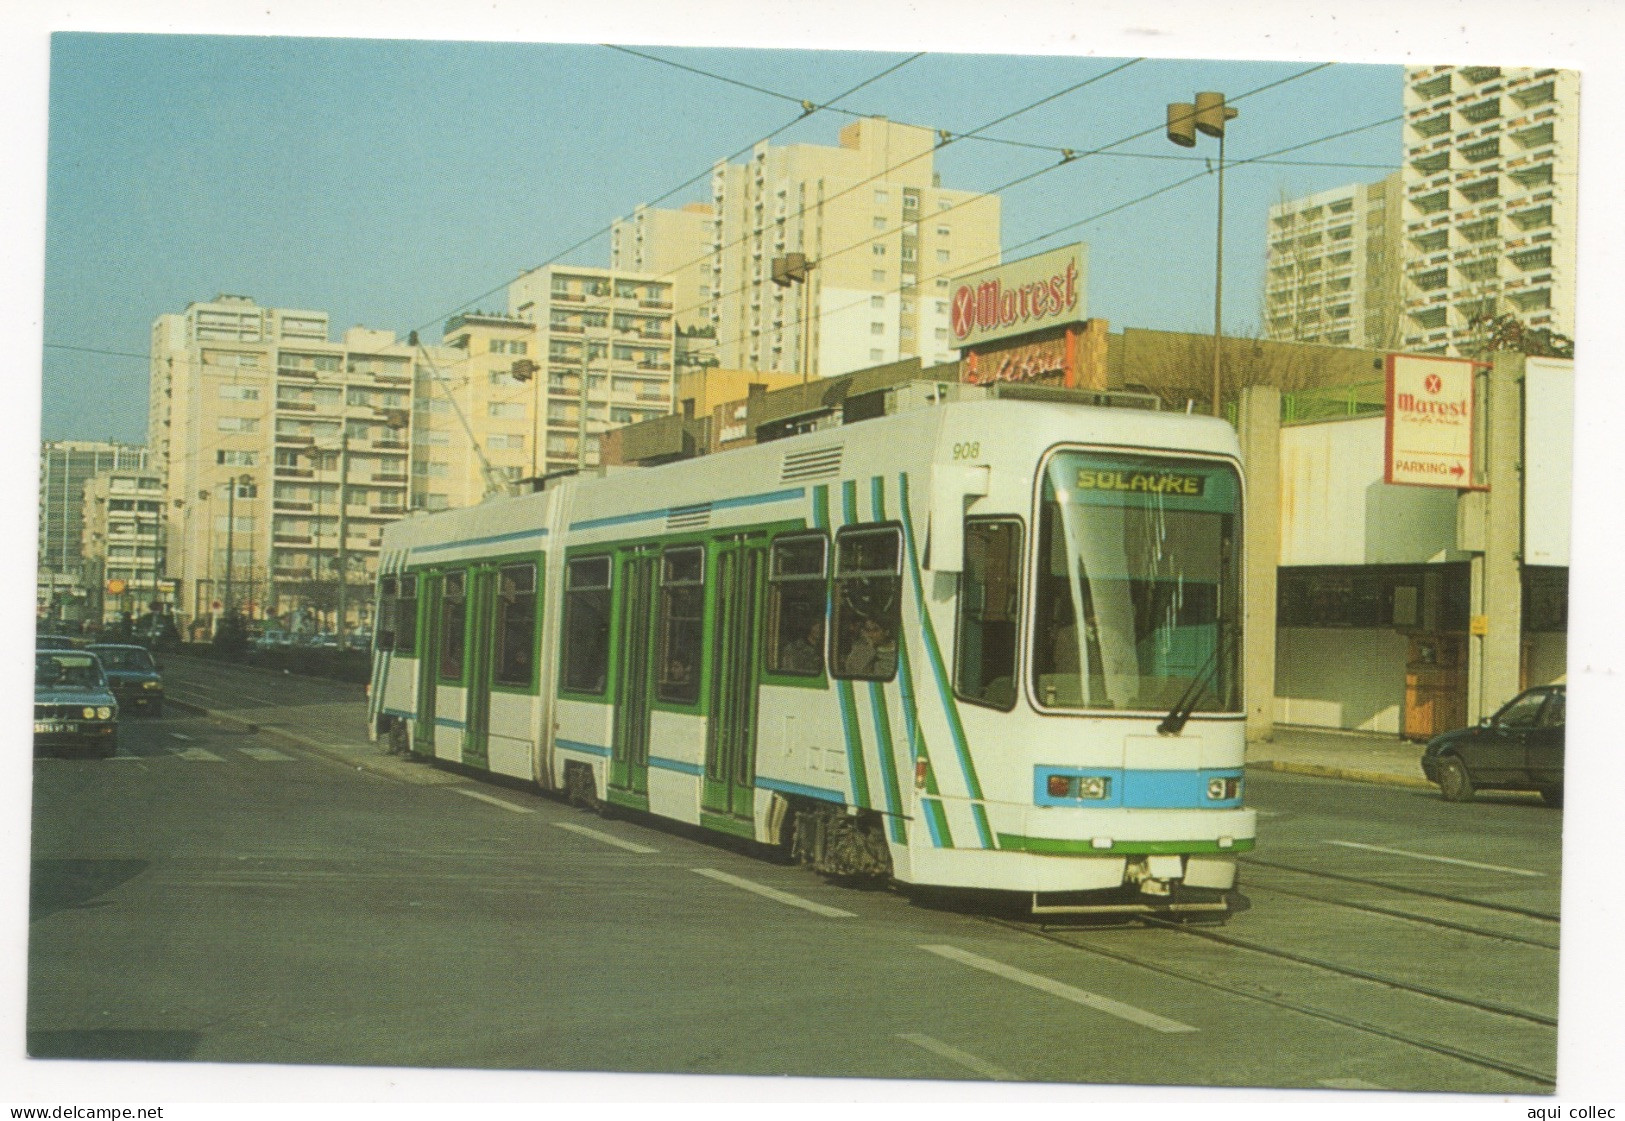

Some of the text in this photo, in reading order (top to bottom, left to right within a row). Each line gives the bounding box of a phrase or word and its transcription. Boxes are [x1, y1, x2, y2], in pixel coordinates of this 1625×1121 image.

[976, 257, 1078, 332] Marest
[1398, 394, 1467, 416] Marest
[953, 442, 980, 460] 908
[1396, 460, 1448, 475] PARKING
[1077, 469, 1199, 493] SOLAURE
